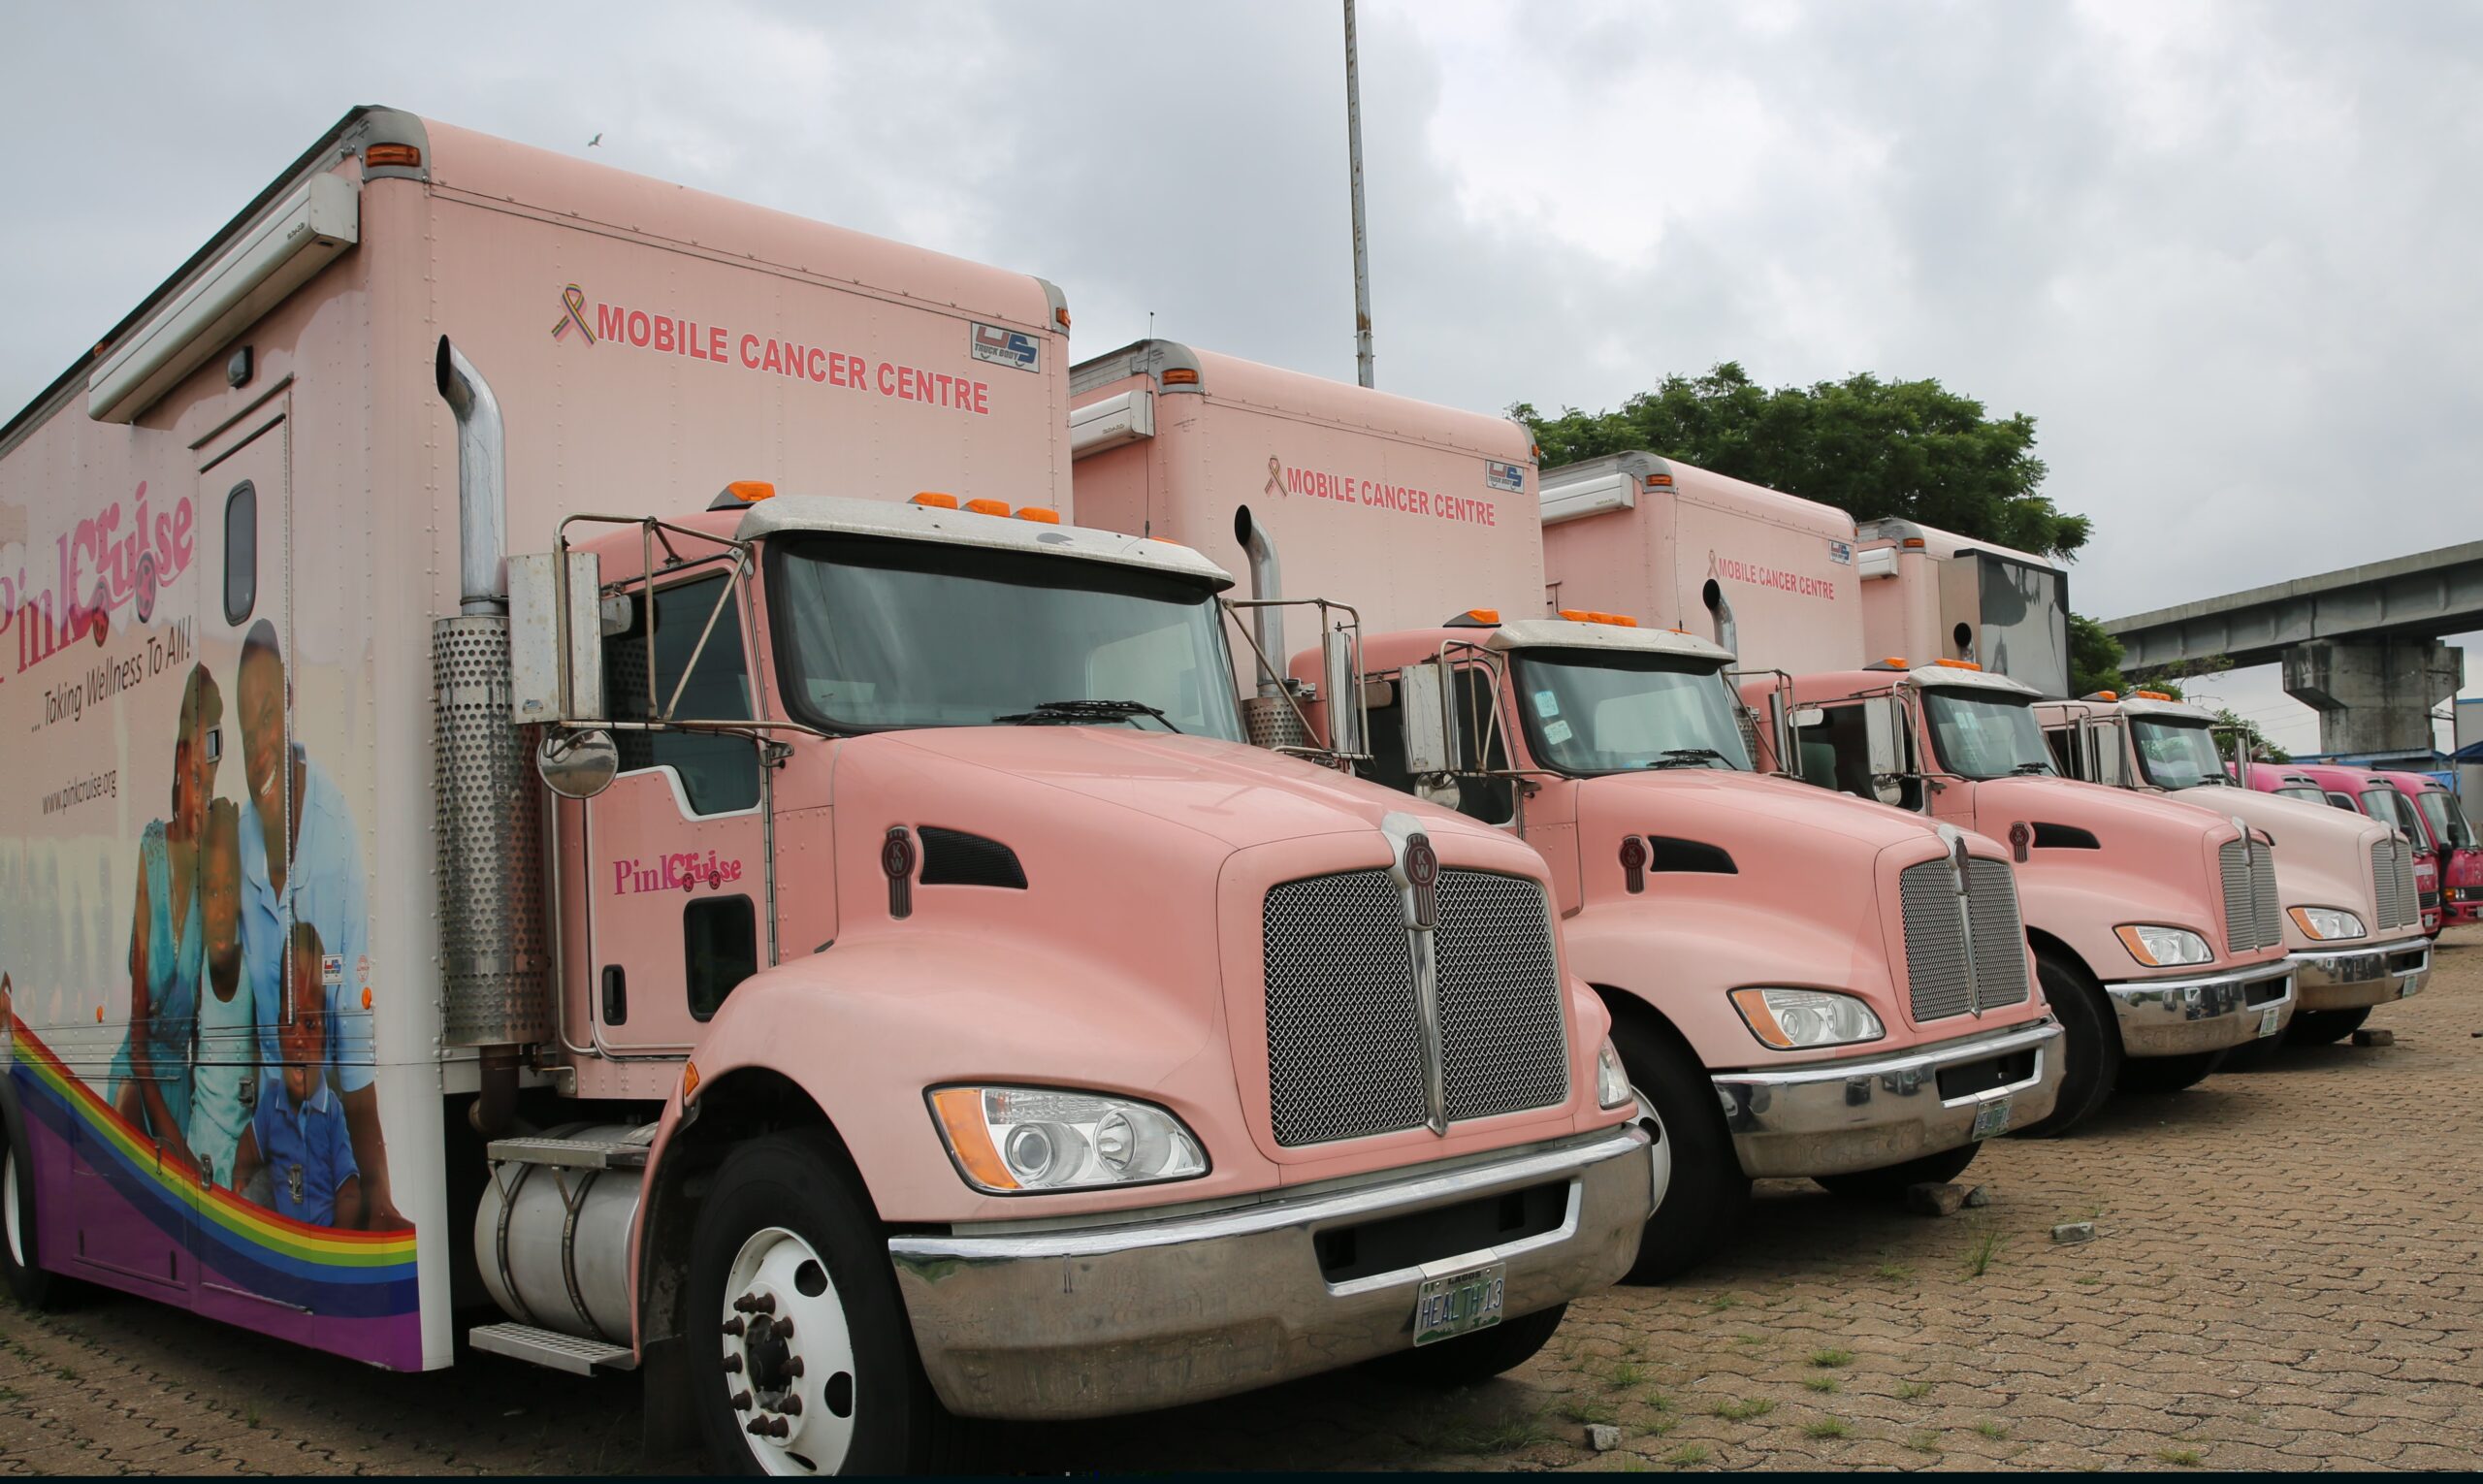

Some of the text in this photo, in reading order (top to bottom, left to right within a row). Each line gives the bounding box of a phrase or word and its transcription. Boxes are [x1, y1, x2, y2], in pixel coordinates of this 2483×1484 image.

[597, 303, 990, 416] MOBILE CANCER CENTRE
[975, 342, 1019, 361] TRUCK BODY
[976, 325, 1037, 365] US
[1287, 467, 1496, 528] MOBILE CANCER CENTRE
[1719, 558, 1834, 600] MOBILE CANCER CENTRE
[45, 681, 83, 726] Taking
[86, 653, 143, 707] Wellness
[147, 635, 163, 678] To
[166, 615, 192, 669] All!
[42, 769, 116, 816] www.pinkcruise.org
